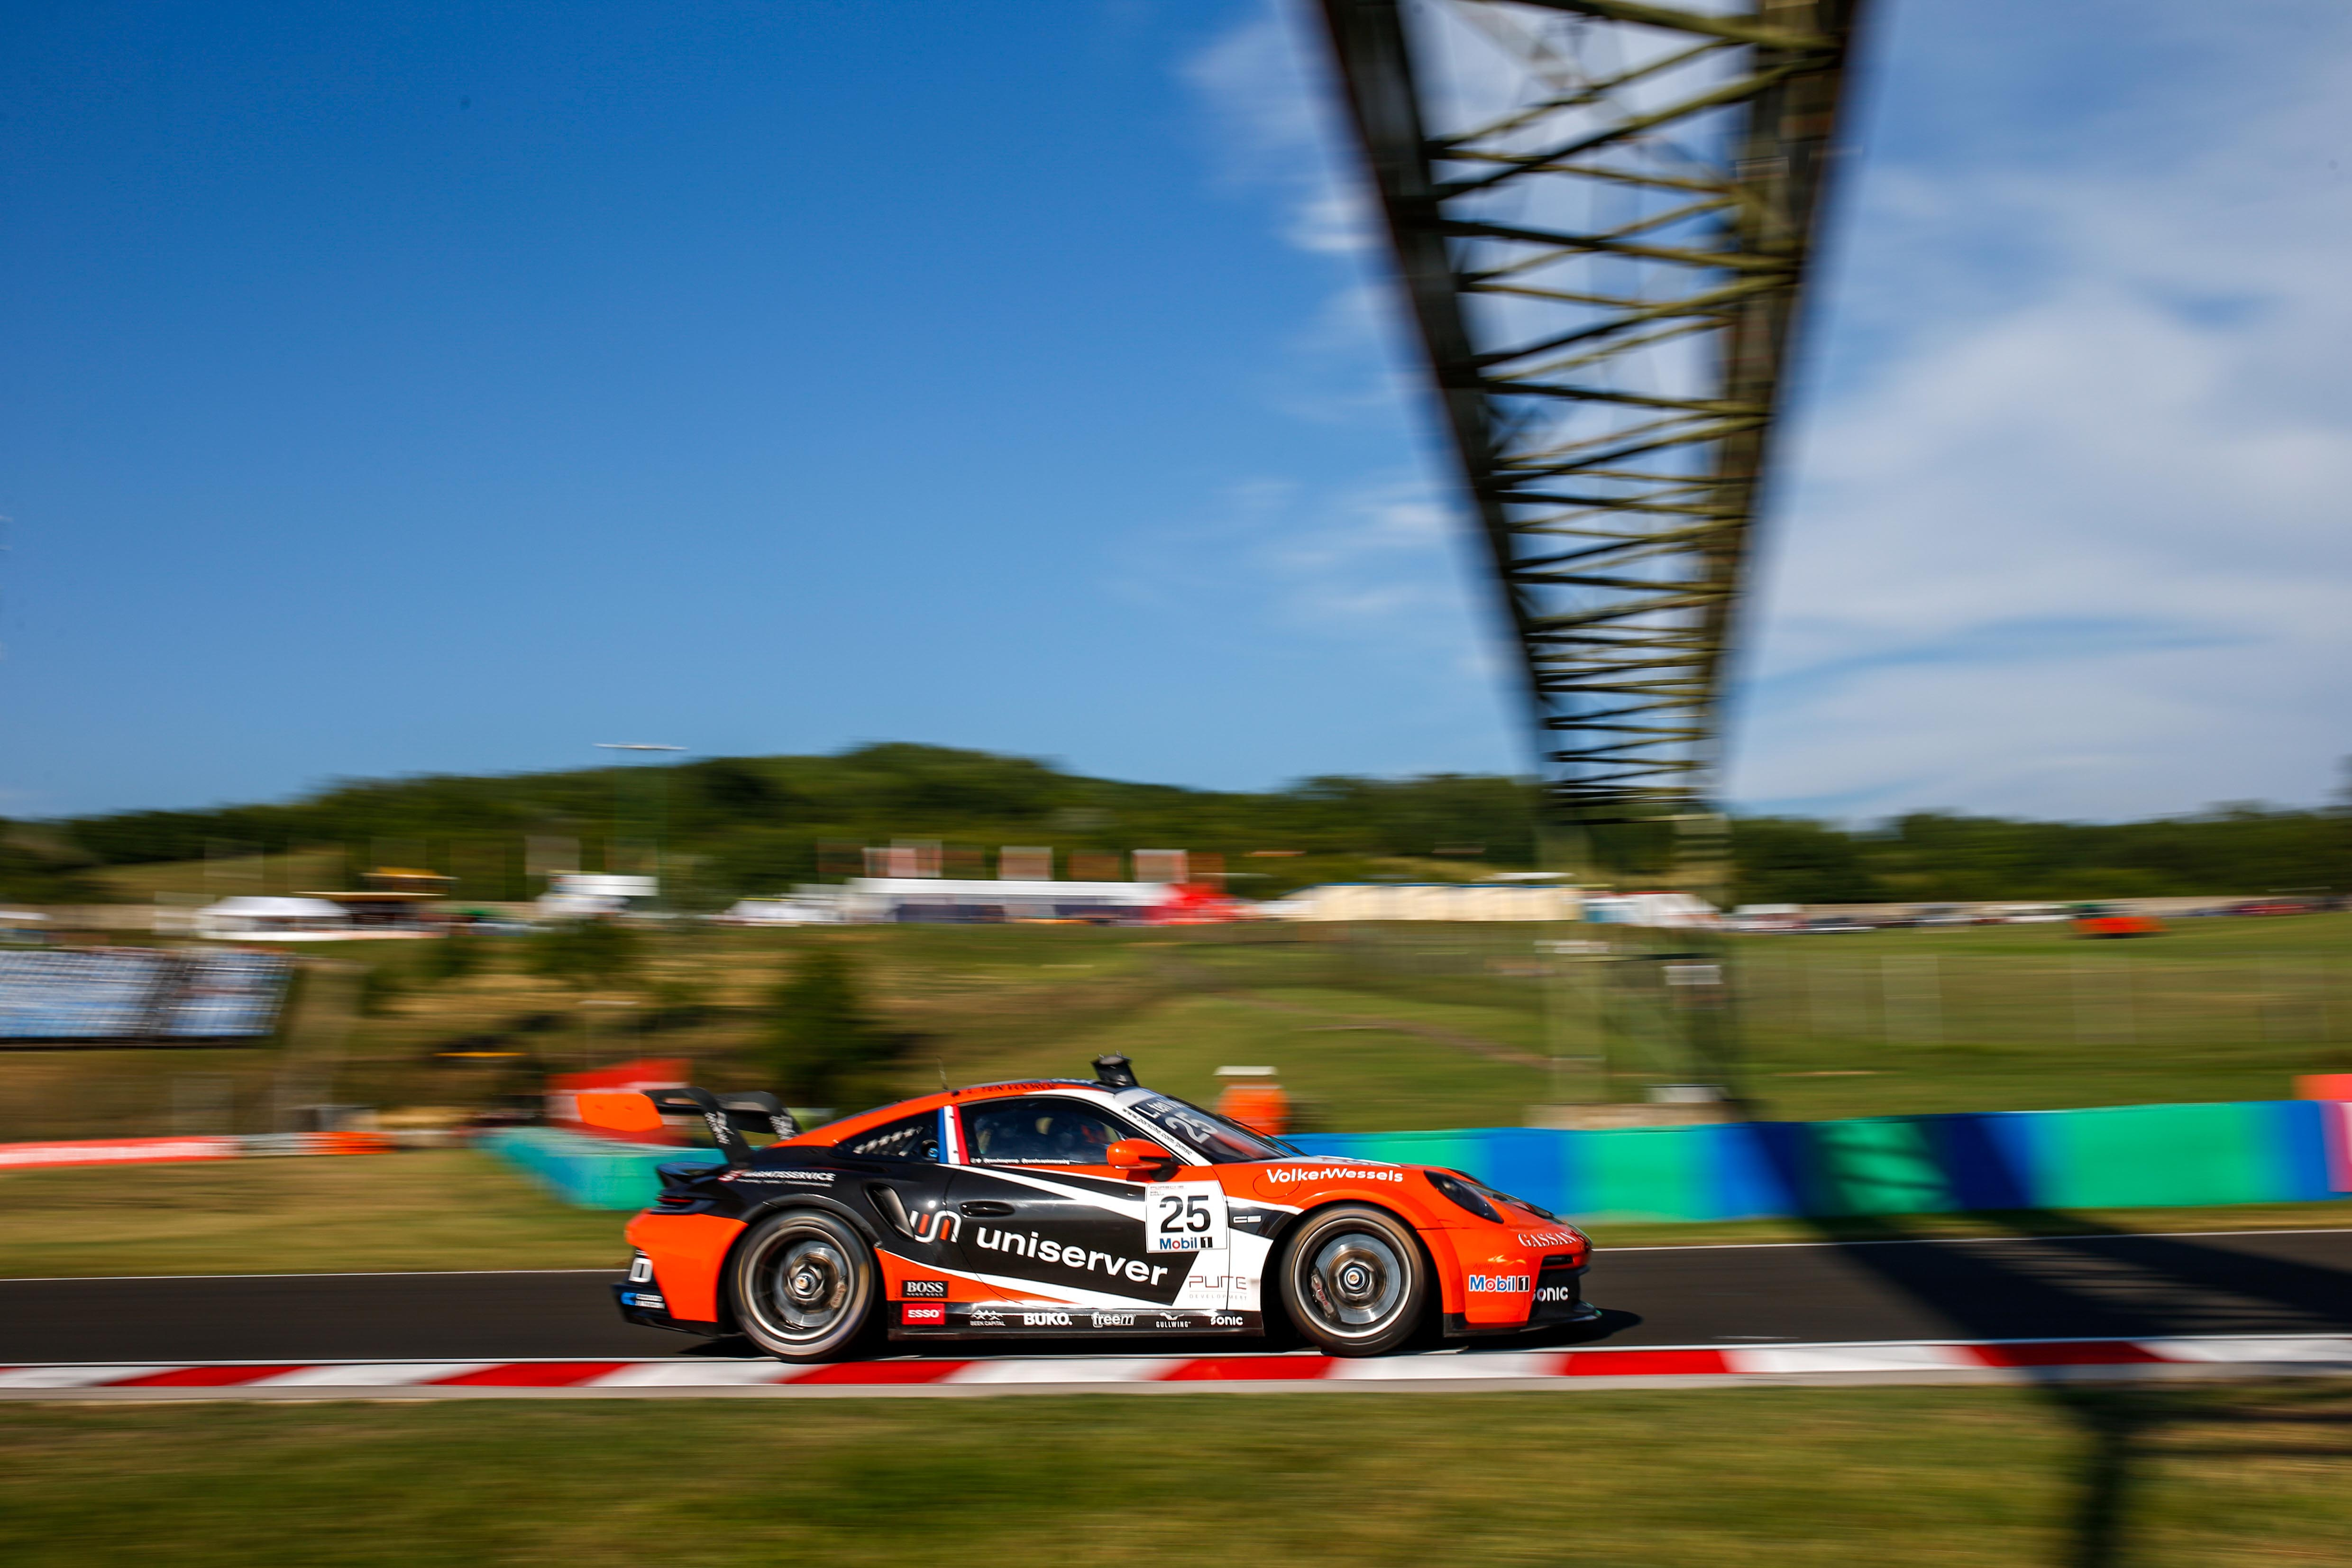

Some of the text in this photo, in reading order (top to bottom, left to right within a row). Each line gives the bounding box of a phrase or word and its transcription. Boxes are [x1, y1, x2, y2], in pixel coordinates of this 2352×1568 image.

[1165, 1112, 1219, 1144] 25
[1266, 1168, 1403, 1183] VolkerWessels
[1160, 1195, 1211, 1234] 25
[1160, 1237, 1198, 1250] Mobil
[1518, 1232, 1577, 1247] GASSAN
[976, 1227, 1168, 1286] uniserver
[906, 1282, 944, 1293] BOSS
[1469, 1275, 1516, 1293] Mobil
[1091, 1311, 1136, 1328] freem
